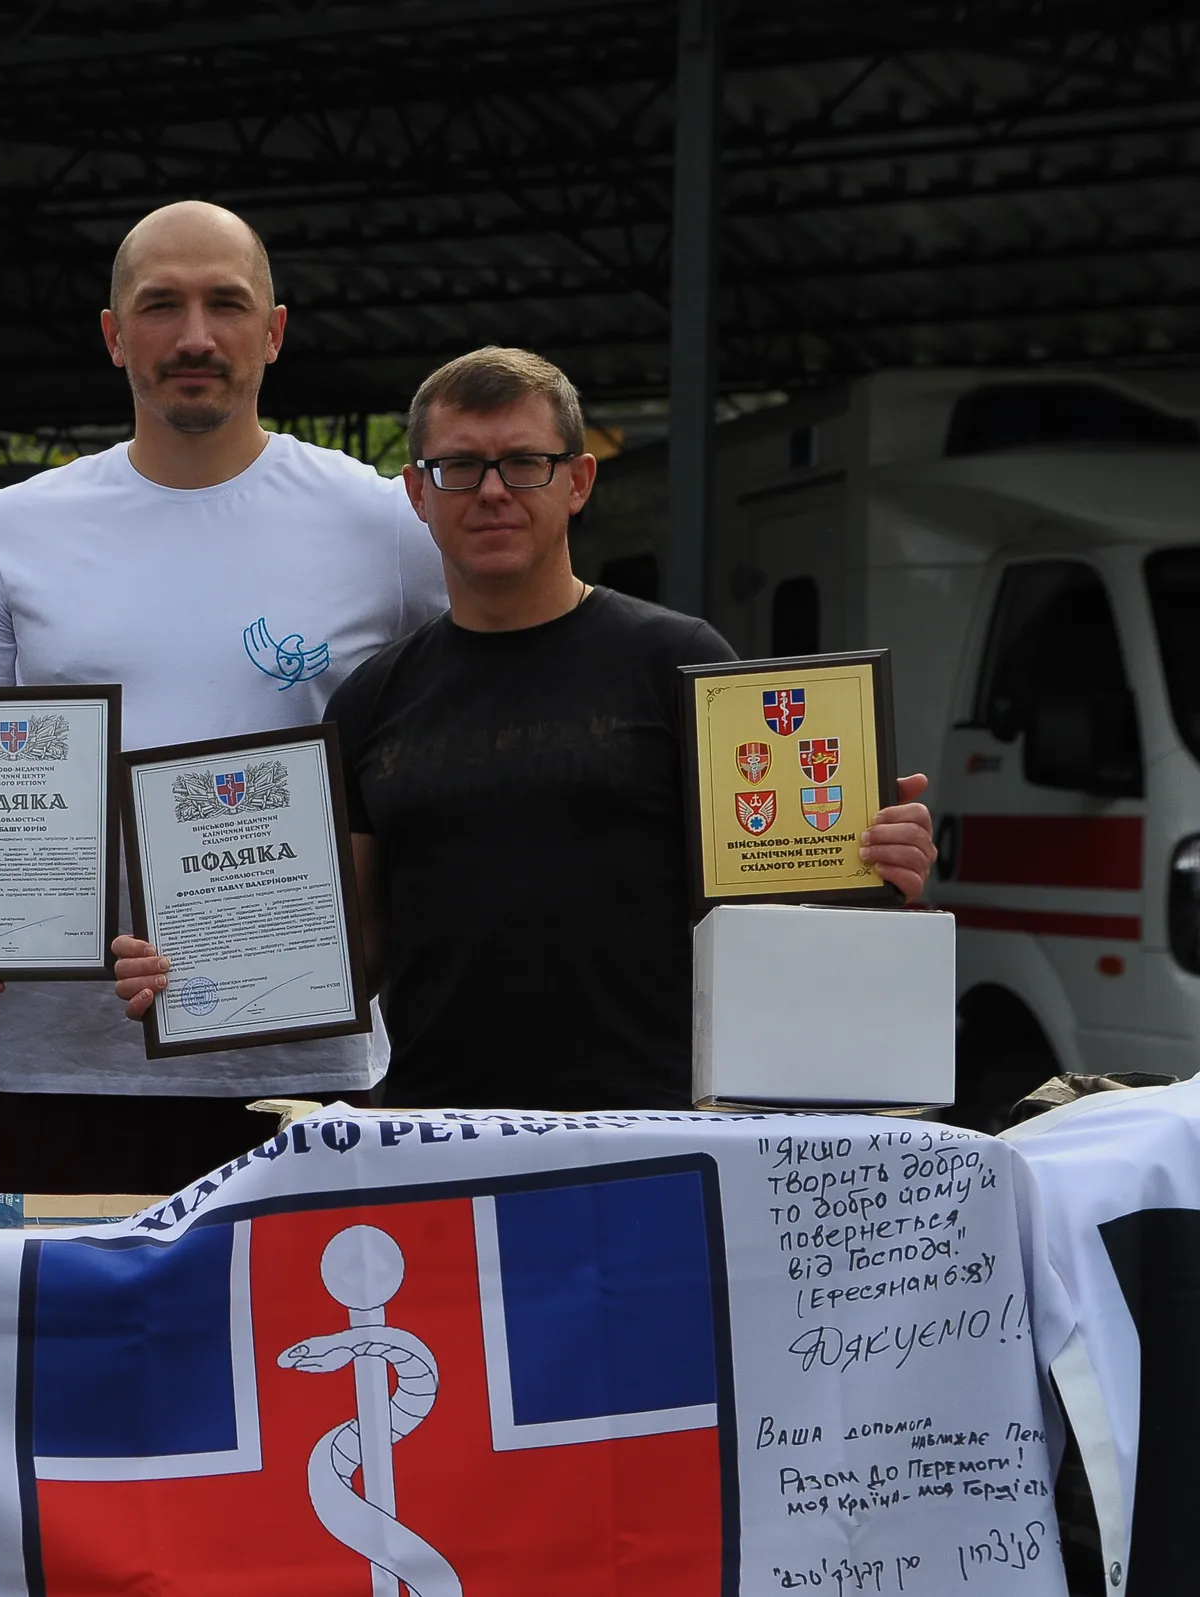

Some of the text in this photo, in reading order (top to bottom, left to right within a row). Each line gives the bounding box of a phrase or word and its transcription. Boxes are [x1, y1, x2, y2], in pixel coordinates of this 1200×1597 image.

[23, 825, 47, 833] ЮРІЮ
[202, 831, 271, 845] СХІДНОГО РЕГІОНУ
[727, 833, 856, 849] ВІЙСЬКОВО-МЕДИЧНИЙ
[180, 841, 298, 874] ПОДЯКА
[742, 847, 842, 860] КЛІНІЧНИЙ ЦЕНТР
[741, 859, 844, 872] СХІДНОГО РЕГІОНУ
[176, 887, 216, 897] ФРОЛОВУ
[217, 883, 244, 892] ПАВЛУ
[868, 1132, 911, 1151] хто
[768, 1146, 984, 1197] творить добро,
[769, 1204, 800, 1225] то
[813, 1188, 887, 1220] добро
[899, 1177, 971, 1203] йому
[780, 1209, 959, 1251] повернеться
[788, 1254, 833, 1281] від
